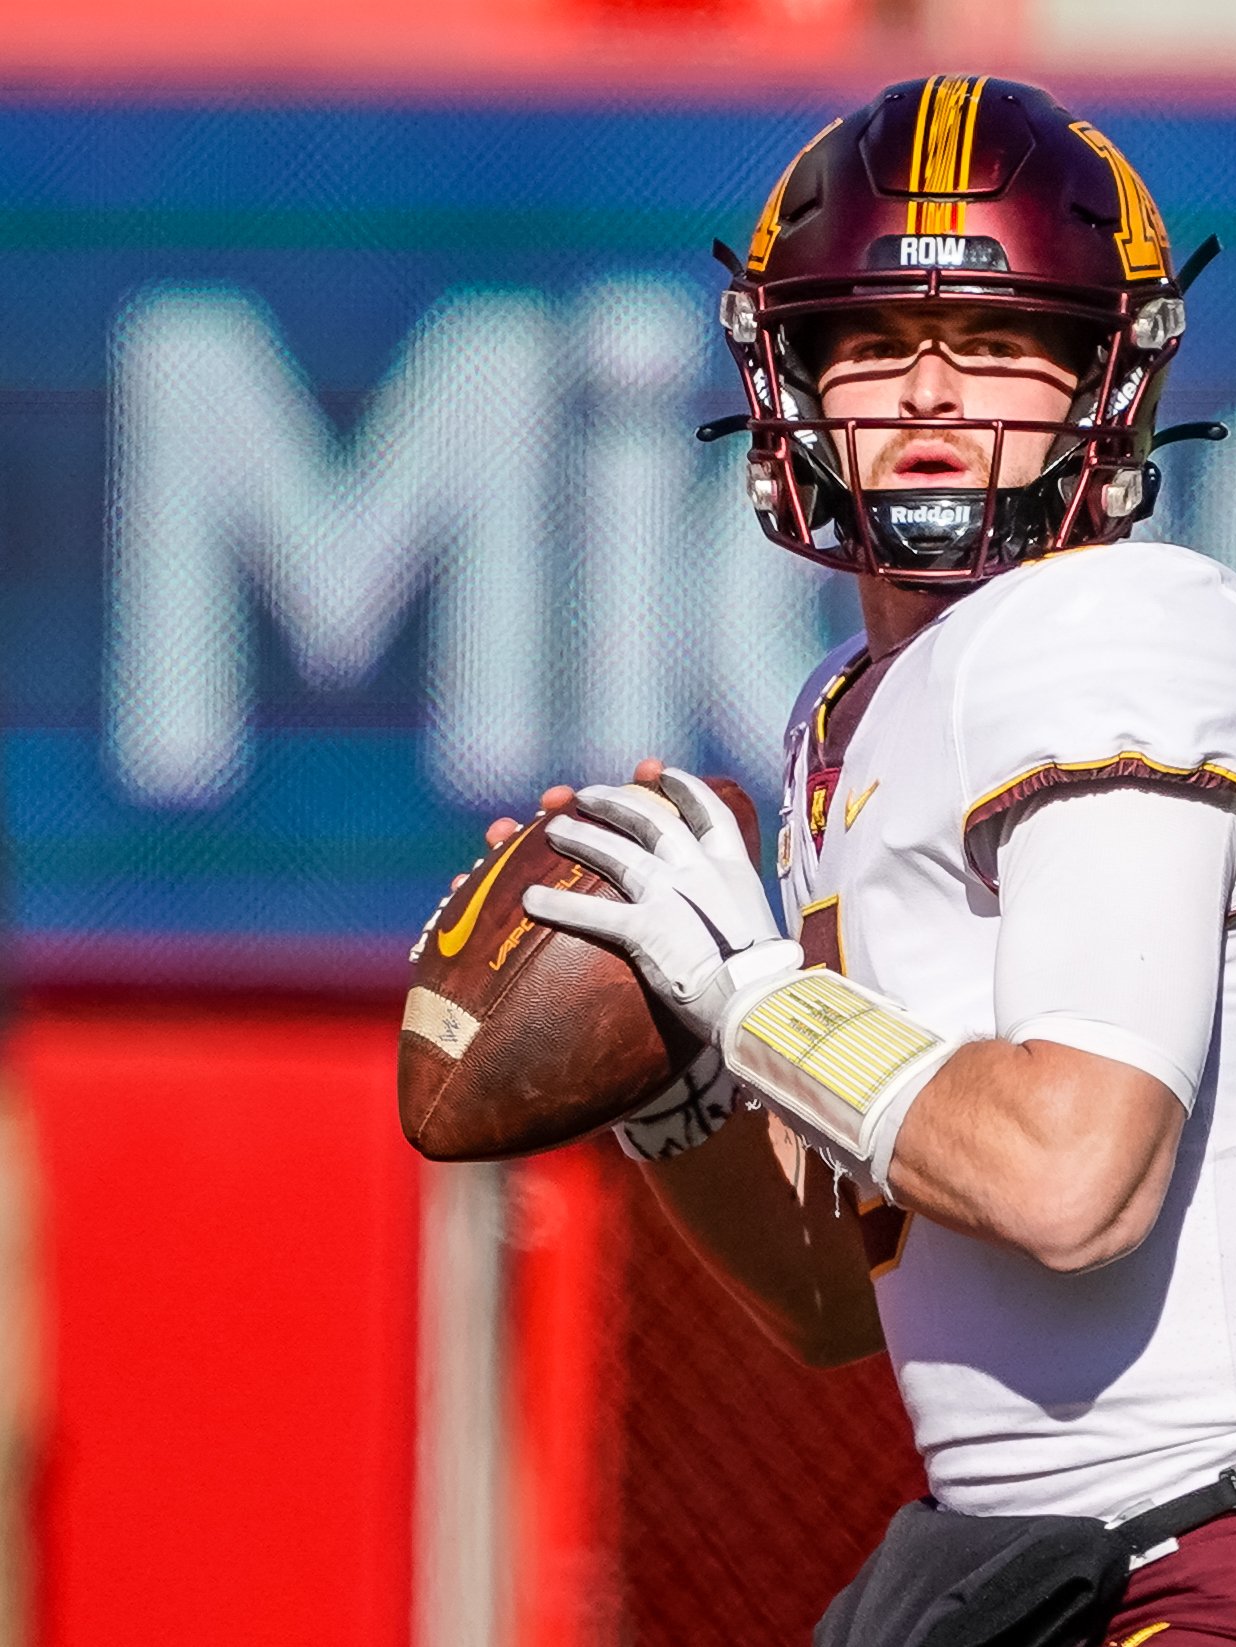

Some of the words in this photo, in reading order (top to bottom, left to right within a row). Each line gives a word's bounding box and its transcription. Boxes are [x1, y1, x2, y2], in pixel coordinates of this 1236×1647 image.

[900, 237, 966, 266] ROW
[890, 505, 971, 524] Riddell
[488, 917, 536, 971] VAPO
